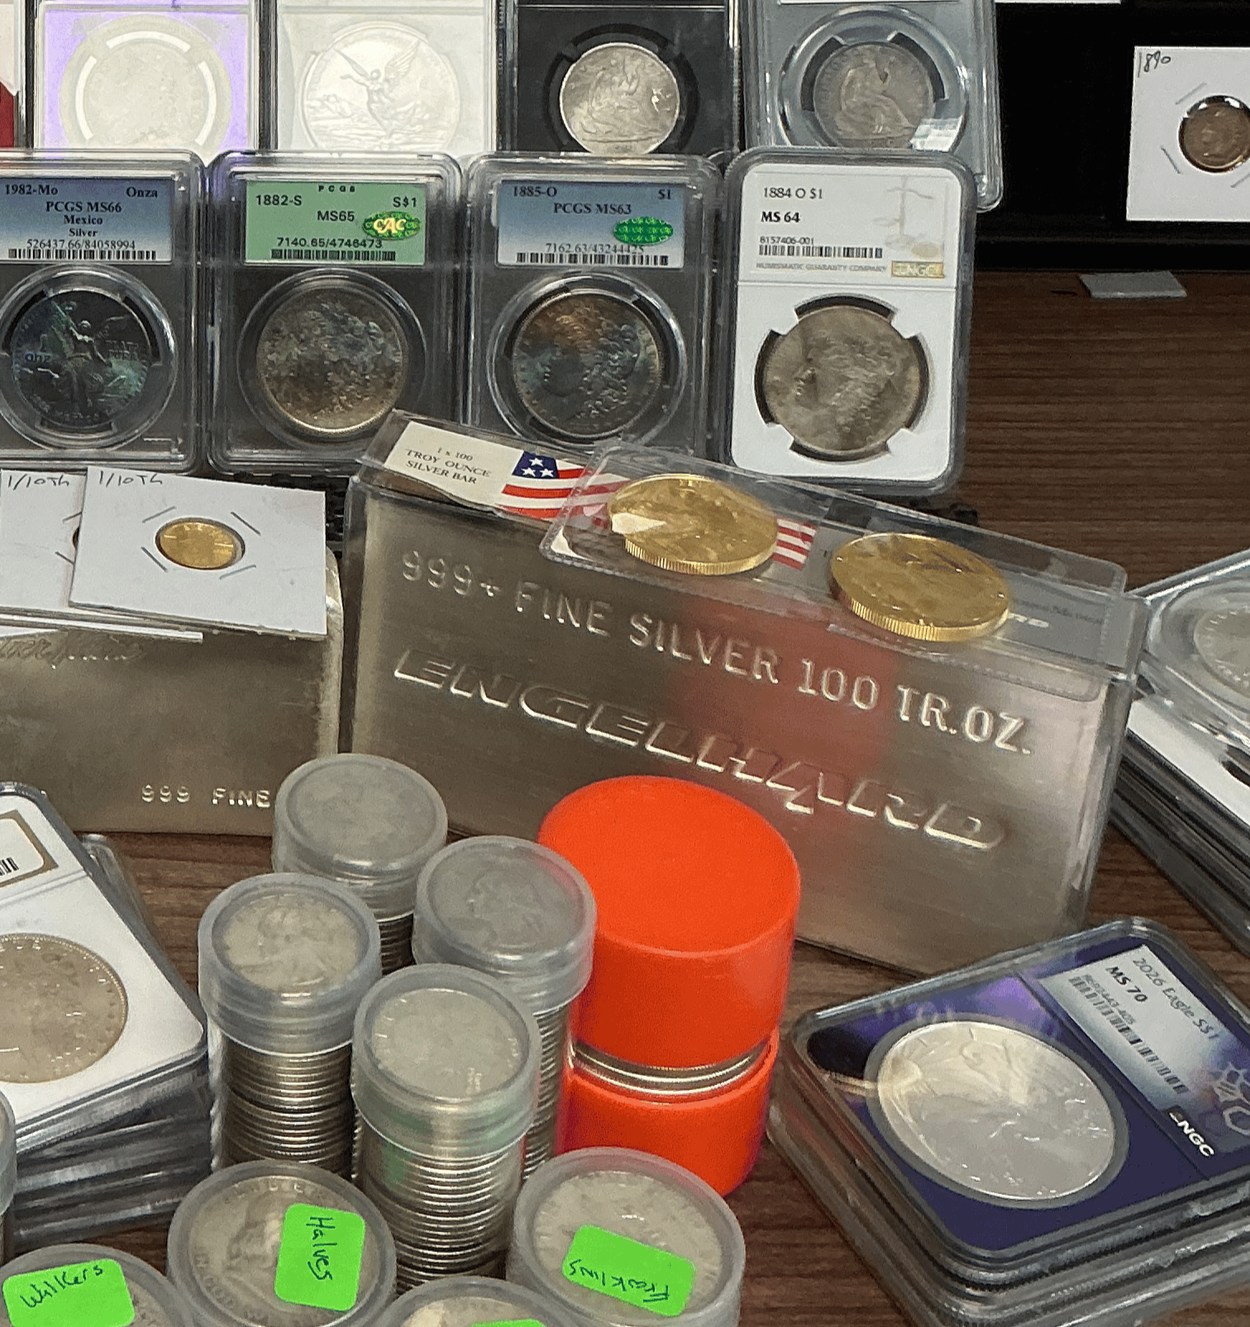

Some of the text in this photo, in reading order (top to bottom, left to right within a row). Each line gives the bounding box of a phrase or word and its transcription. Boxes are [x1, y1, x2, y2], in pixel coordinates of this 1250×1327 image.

[1136, 50, 1171, 78] 1890
[4, 185, 158, 199] 1982-Mo Onza
[255, 194, 418, 209] 1882-S S$1
[45, 201, 123, 213] PCGS MS66
[316, 209, 355, 222] MS65
[553, 203, 632, 216] PCGS MS63
[760, 211, 785, 223] MS
[63, 215, 104, 226] Mexico
[68, 227, 99, 238] Silver
[404, 447, 491, 478] TROY OUNCE
[405, 459, 478, 485] SILVER BAR
[514, 580, 611, 638] FINE
[628, 613, 780, 685] SILVER
[797, 658, 880, 711] 100
[392, 648, 1005, 852] ENGELHARD
[211, 785, 272, 809] FINE
[1105, 965, 1149, 1004] MS 70
[1132, 956, 1166, 988] 2026
[1161, 987, 1196, 1020] Eagle
[1177, 1119, 1215, 1159] NGC
[303, 1215, 334, 1282] Halves
